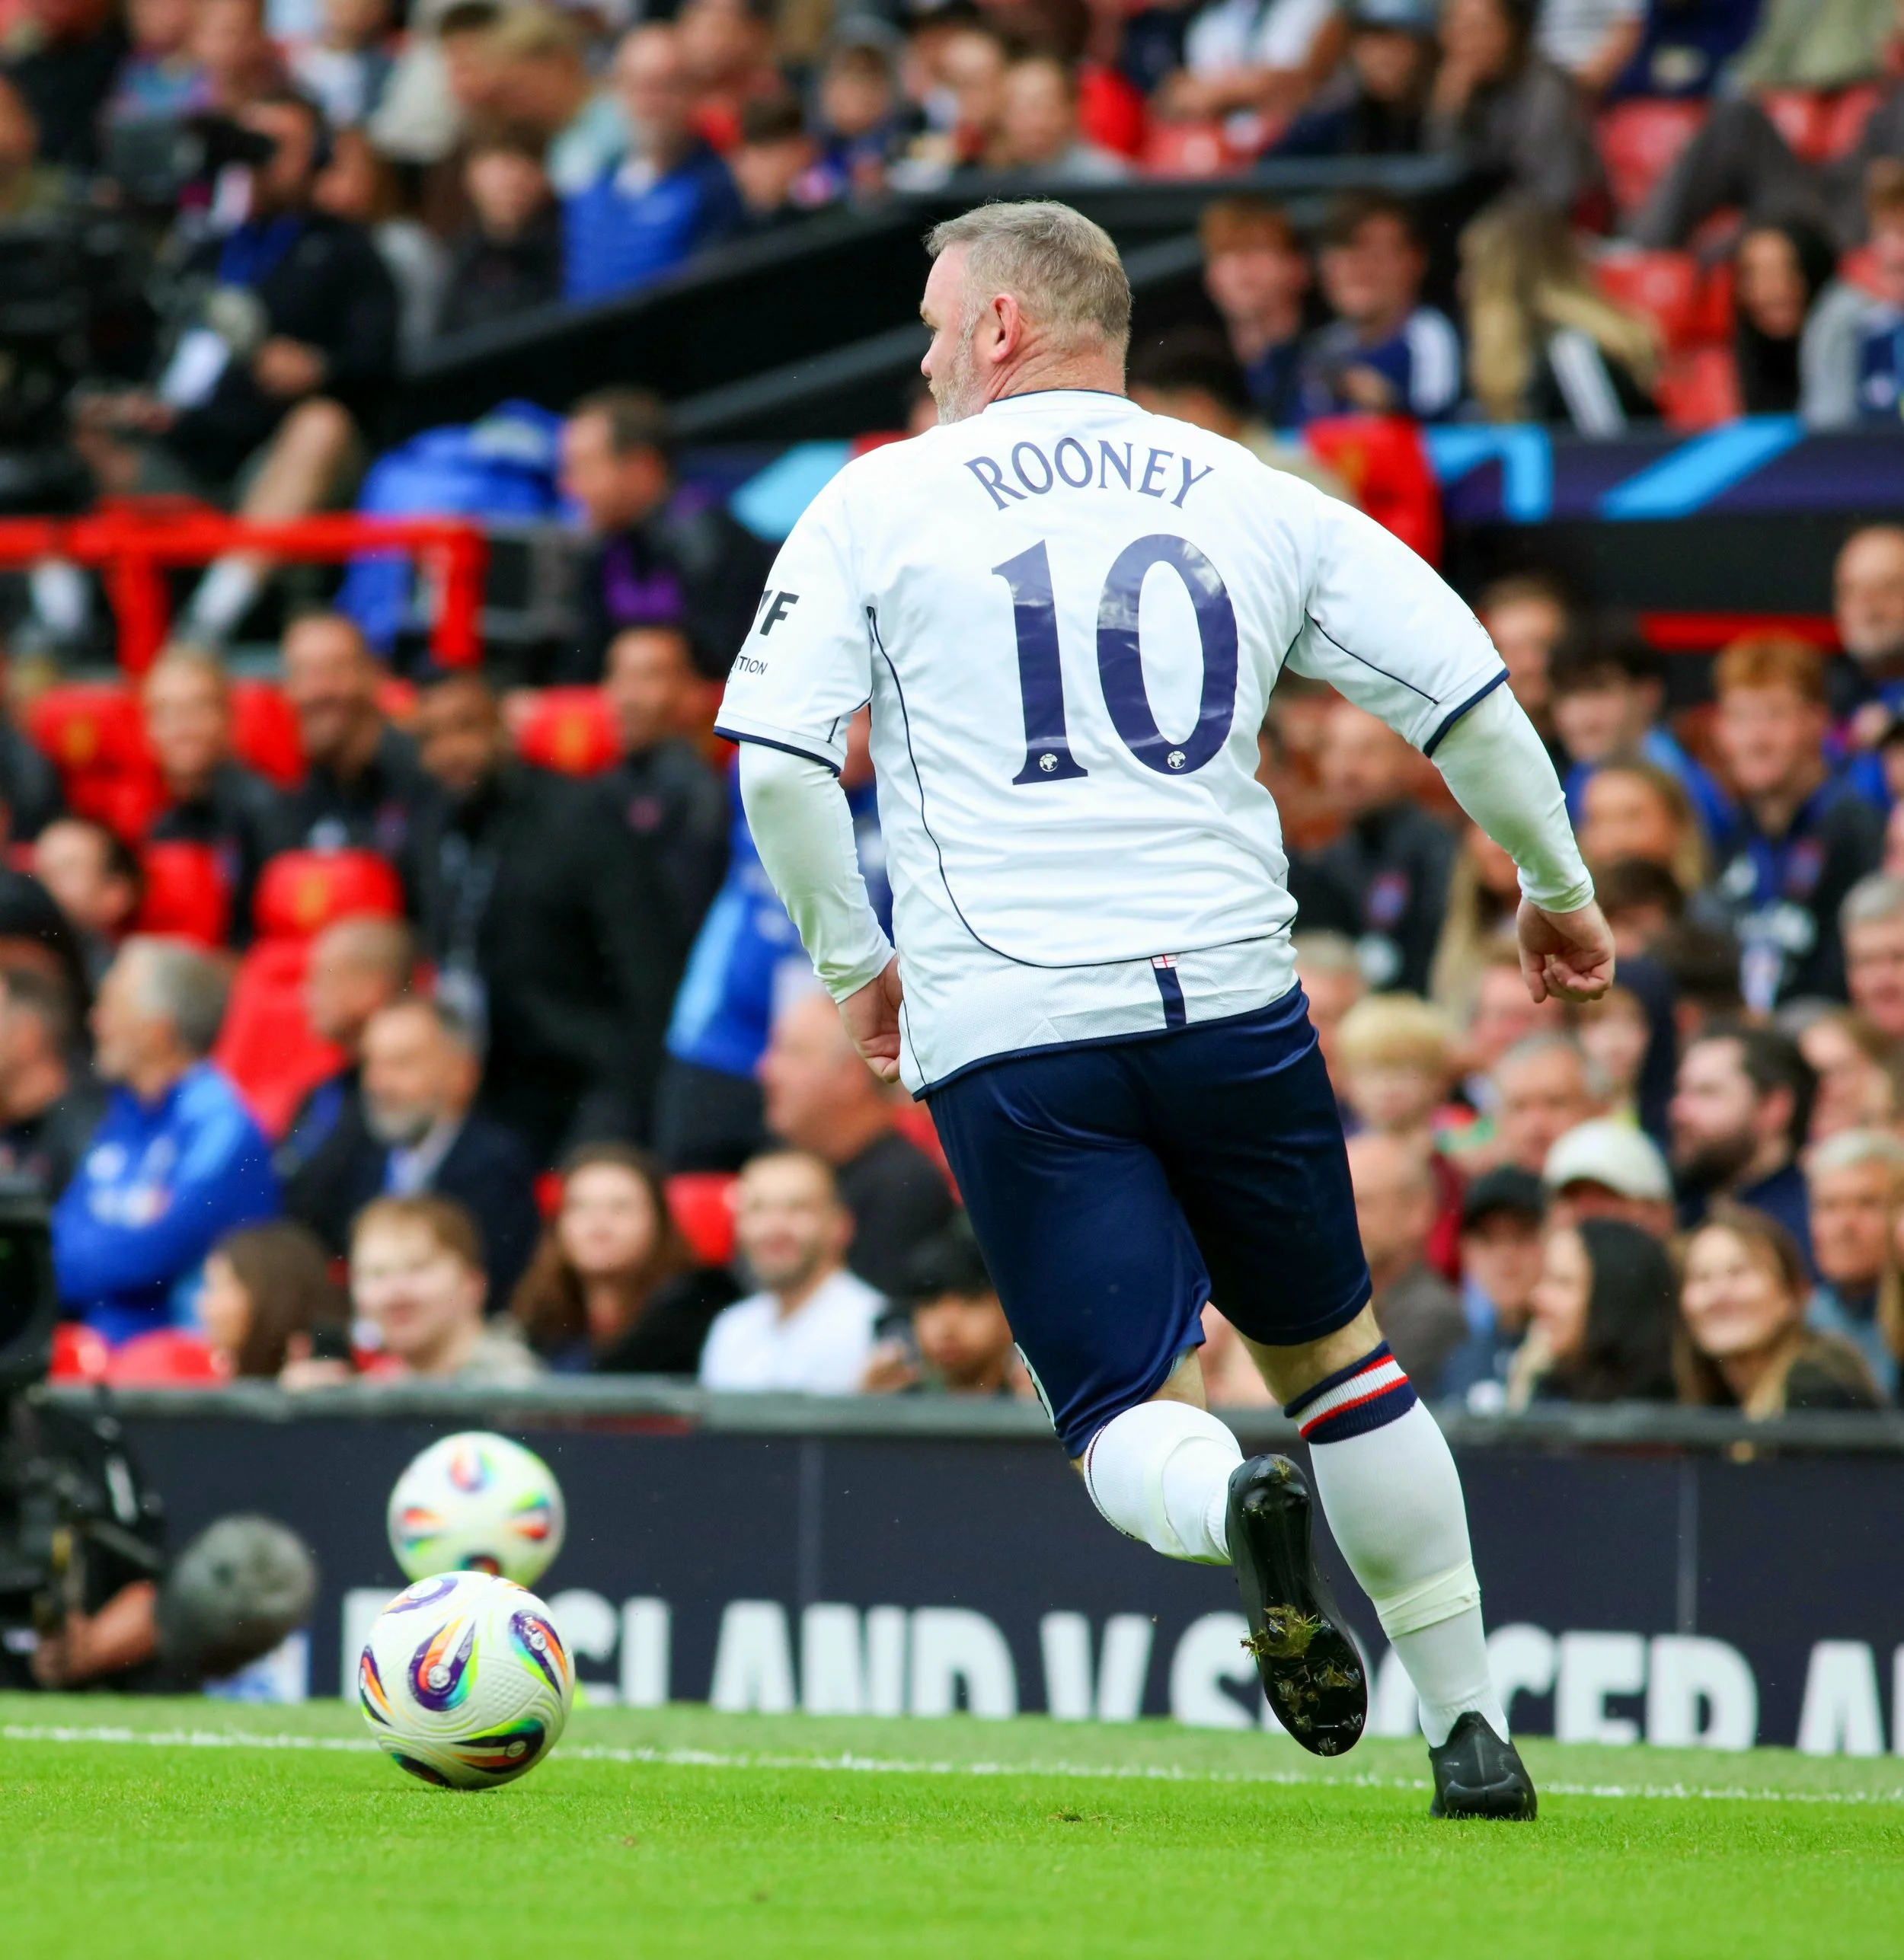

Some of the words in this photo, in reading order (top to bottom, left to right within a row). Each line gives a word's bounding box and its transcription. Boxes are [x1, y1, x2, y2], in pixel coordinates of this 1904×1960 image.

[963, 436, 1214, 511] ROONEY
[759, 589, 800, 636] F
[992, 534, 1238, 785] 10
[1039, 1610, 1155, 1722] V
[1795, 1639, 1904, 1757] A
